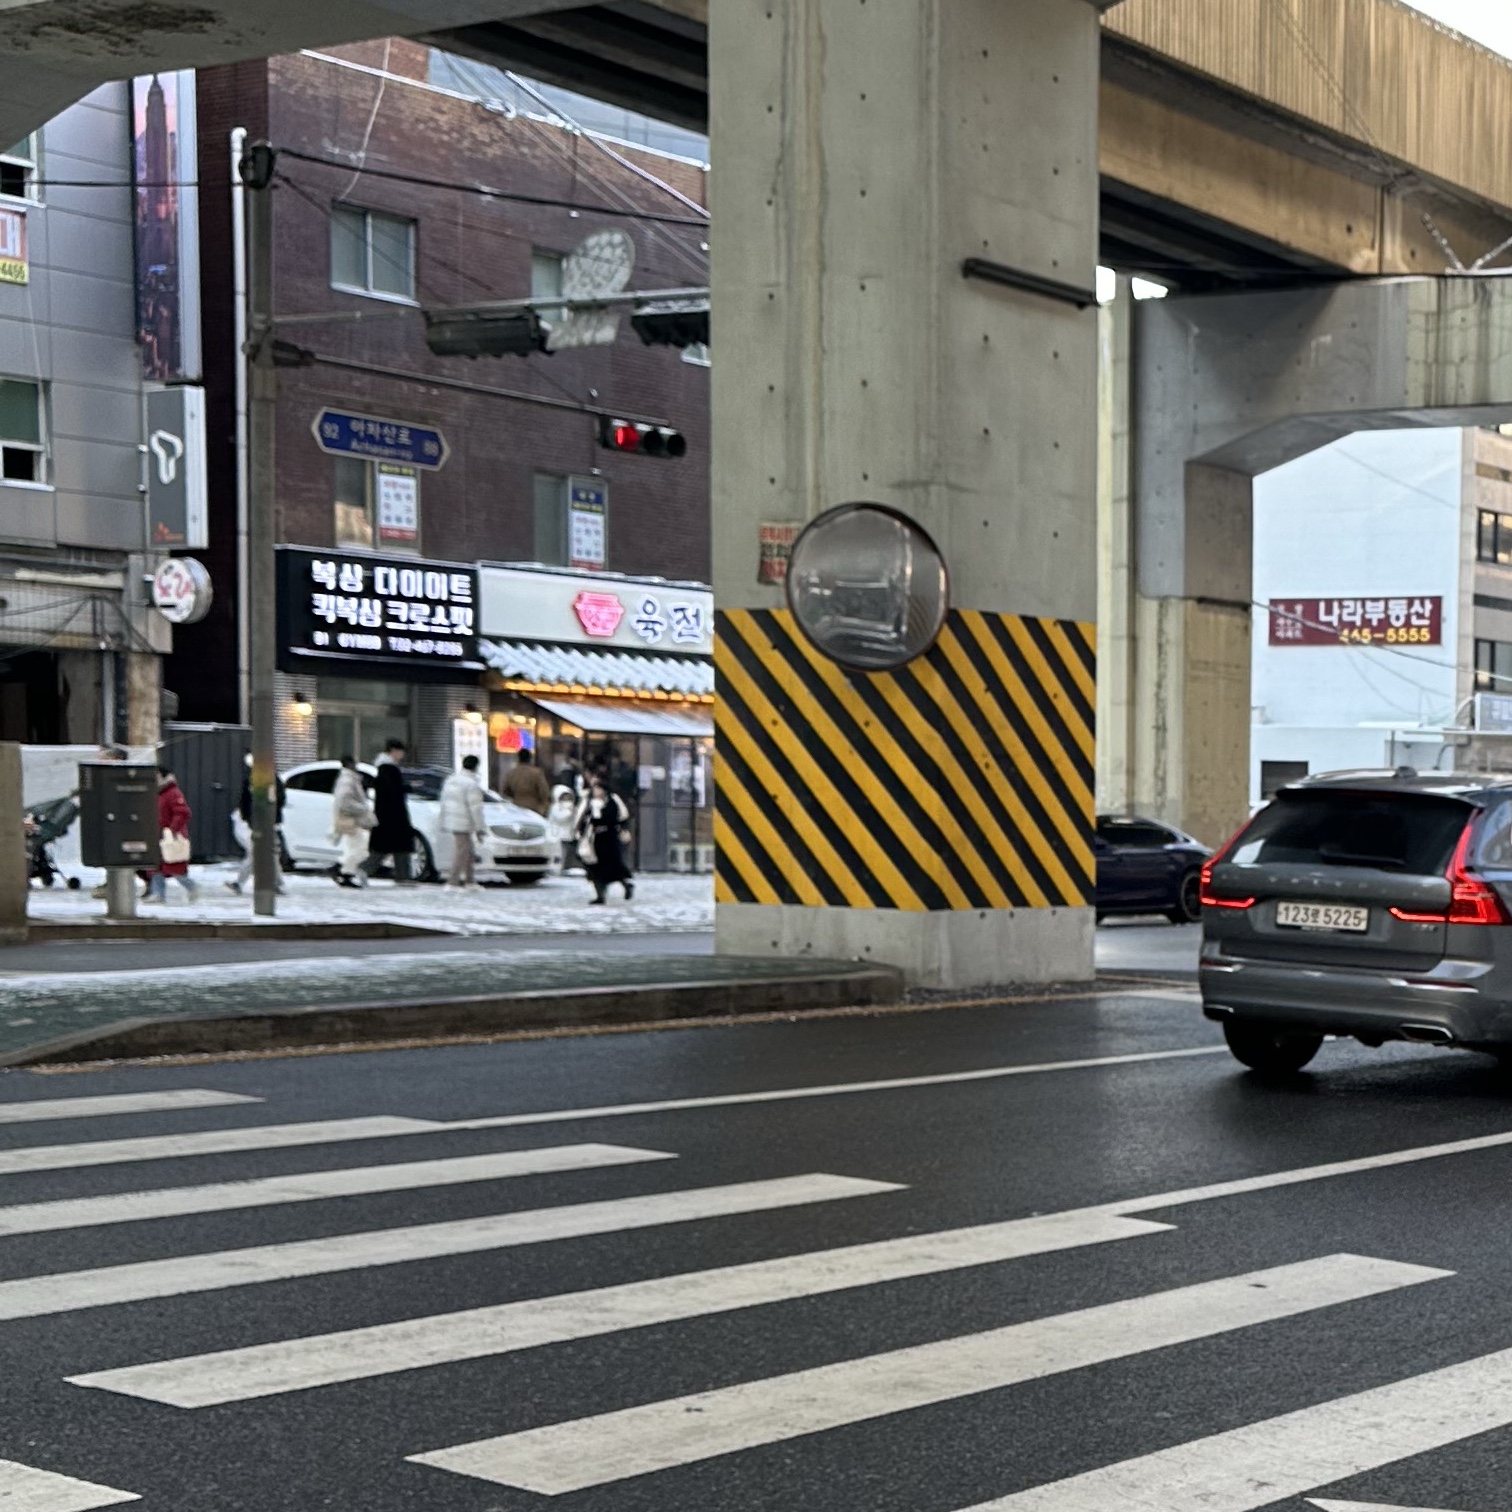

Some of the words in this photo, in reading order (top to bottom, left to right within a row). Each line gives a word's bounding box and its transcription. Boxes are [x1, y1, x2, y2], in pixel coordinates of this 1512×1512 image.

[311, 559, 364, 593] 복싱
[311, 593, 382, 628] 킥복싱
[384, 600, 474, 636] 크로스핏
[1318, 599, 1433, 628] 나라부동산
